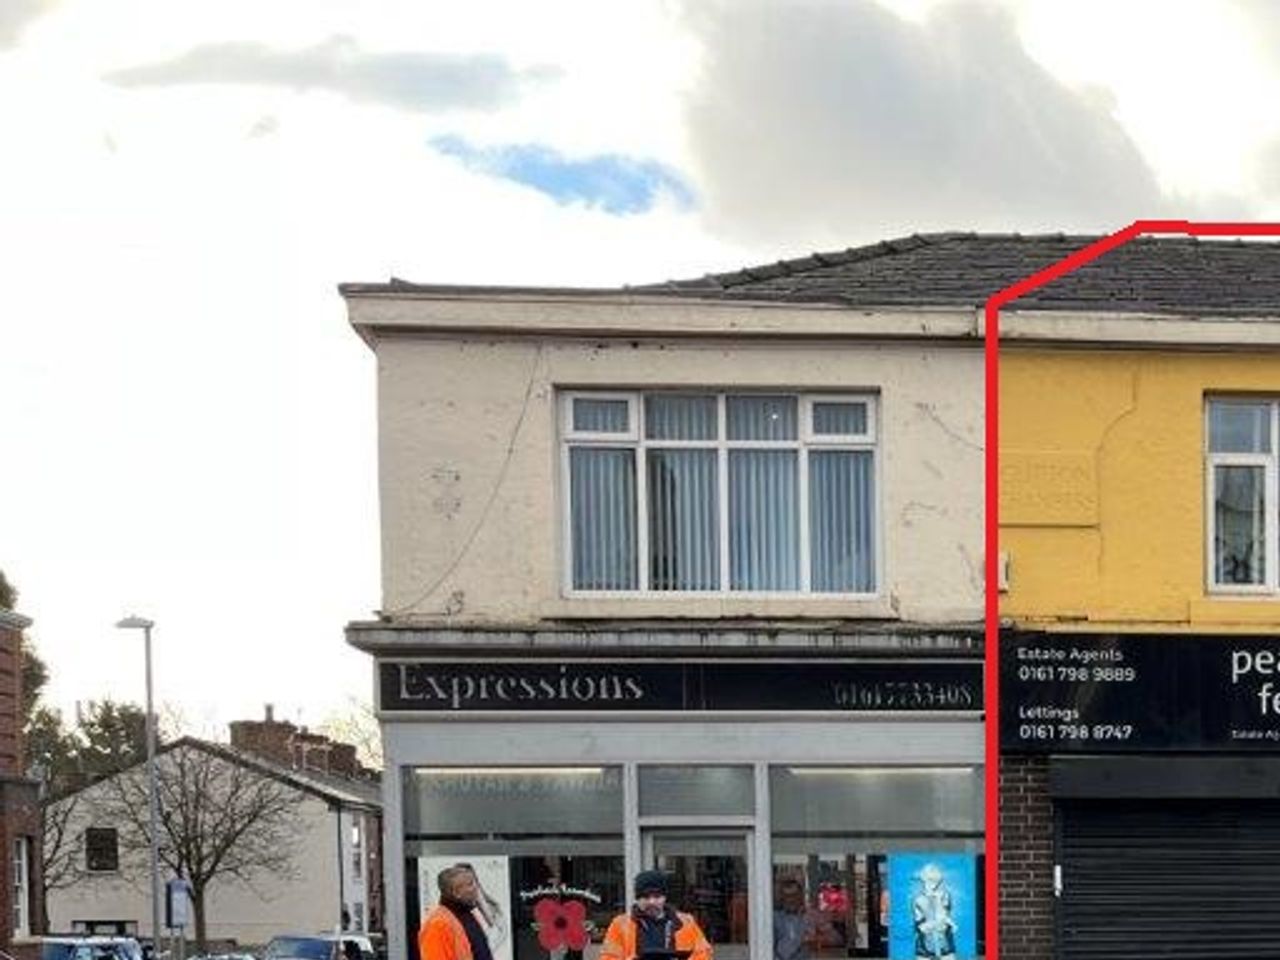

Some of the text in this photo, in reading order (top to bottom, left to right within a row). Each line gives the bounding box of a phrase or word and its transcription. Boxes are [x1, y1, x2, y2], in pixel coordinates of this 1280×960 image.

[1017, 647, 1124, 664] Estate Agents
[1018, 665, 1055, 681] 0161
[1058, 667, 1089, 681] 798
[400, 664, 643, 709] Expressions
[1019, 705, 1080, 721] Lettings
[1019, 724, 1055, 739] 0161
[1058, 724, 1089, 739] 798
